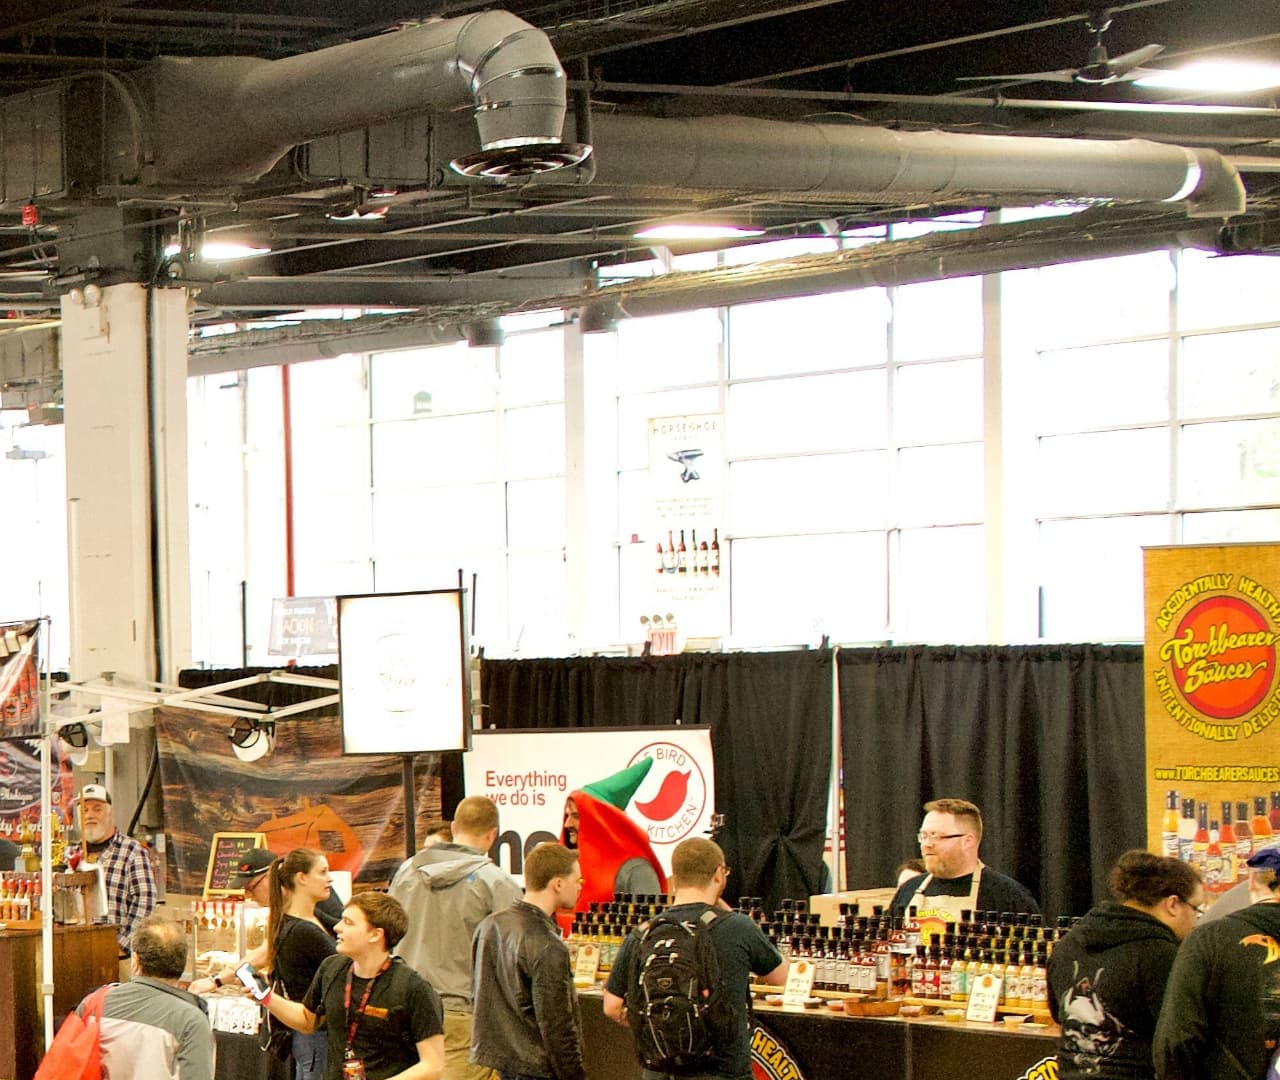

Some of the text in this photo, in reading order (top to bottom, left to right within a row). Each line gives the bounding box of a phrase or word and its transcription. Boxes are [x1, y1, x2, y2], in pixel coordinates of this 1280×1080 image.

[1156, 574, 1233, 632] ACCIDENTALLY
[651, 632, 676, 650] EXIT
[1160, 623, 1280, 669] Torchbearer
[1184, 658, 1268, 694] Sauces
[1154, 667, 1238, 741] INTENTIONALLY
[656, 747, 687, 768] BIRD
[485, 770, 568, 792] Everything
[510, 790, 529, 806] do
[532, 789, 546, 806] is
[646, 803, 699, 838] KITCHEN
